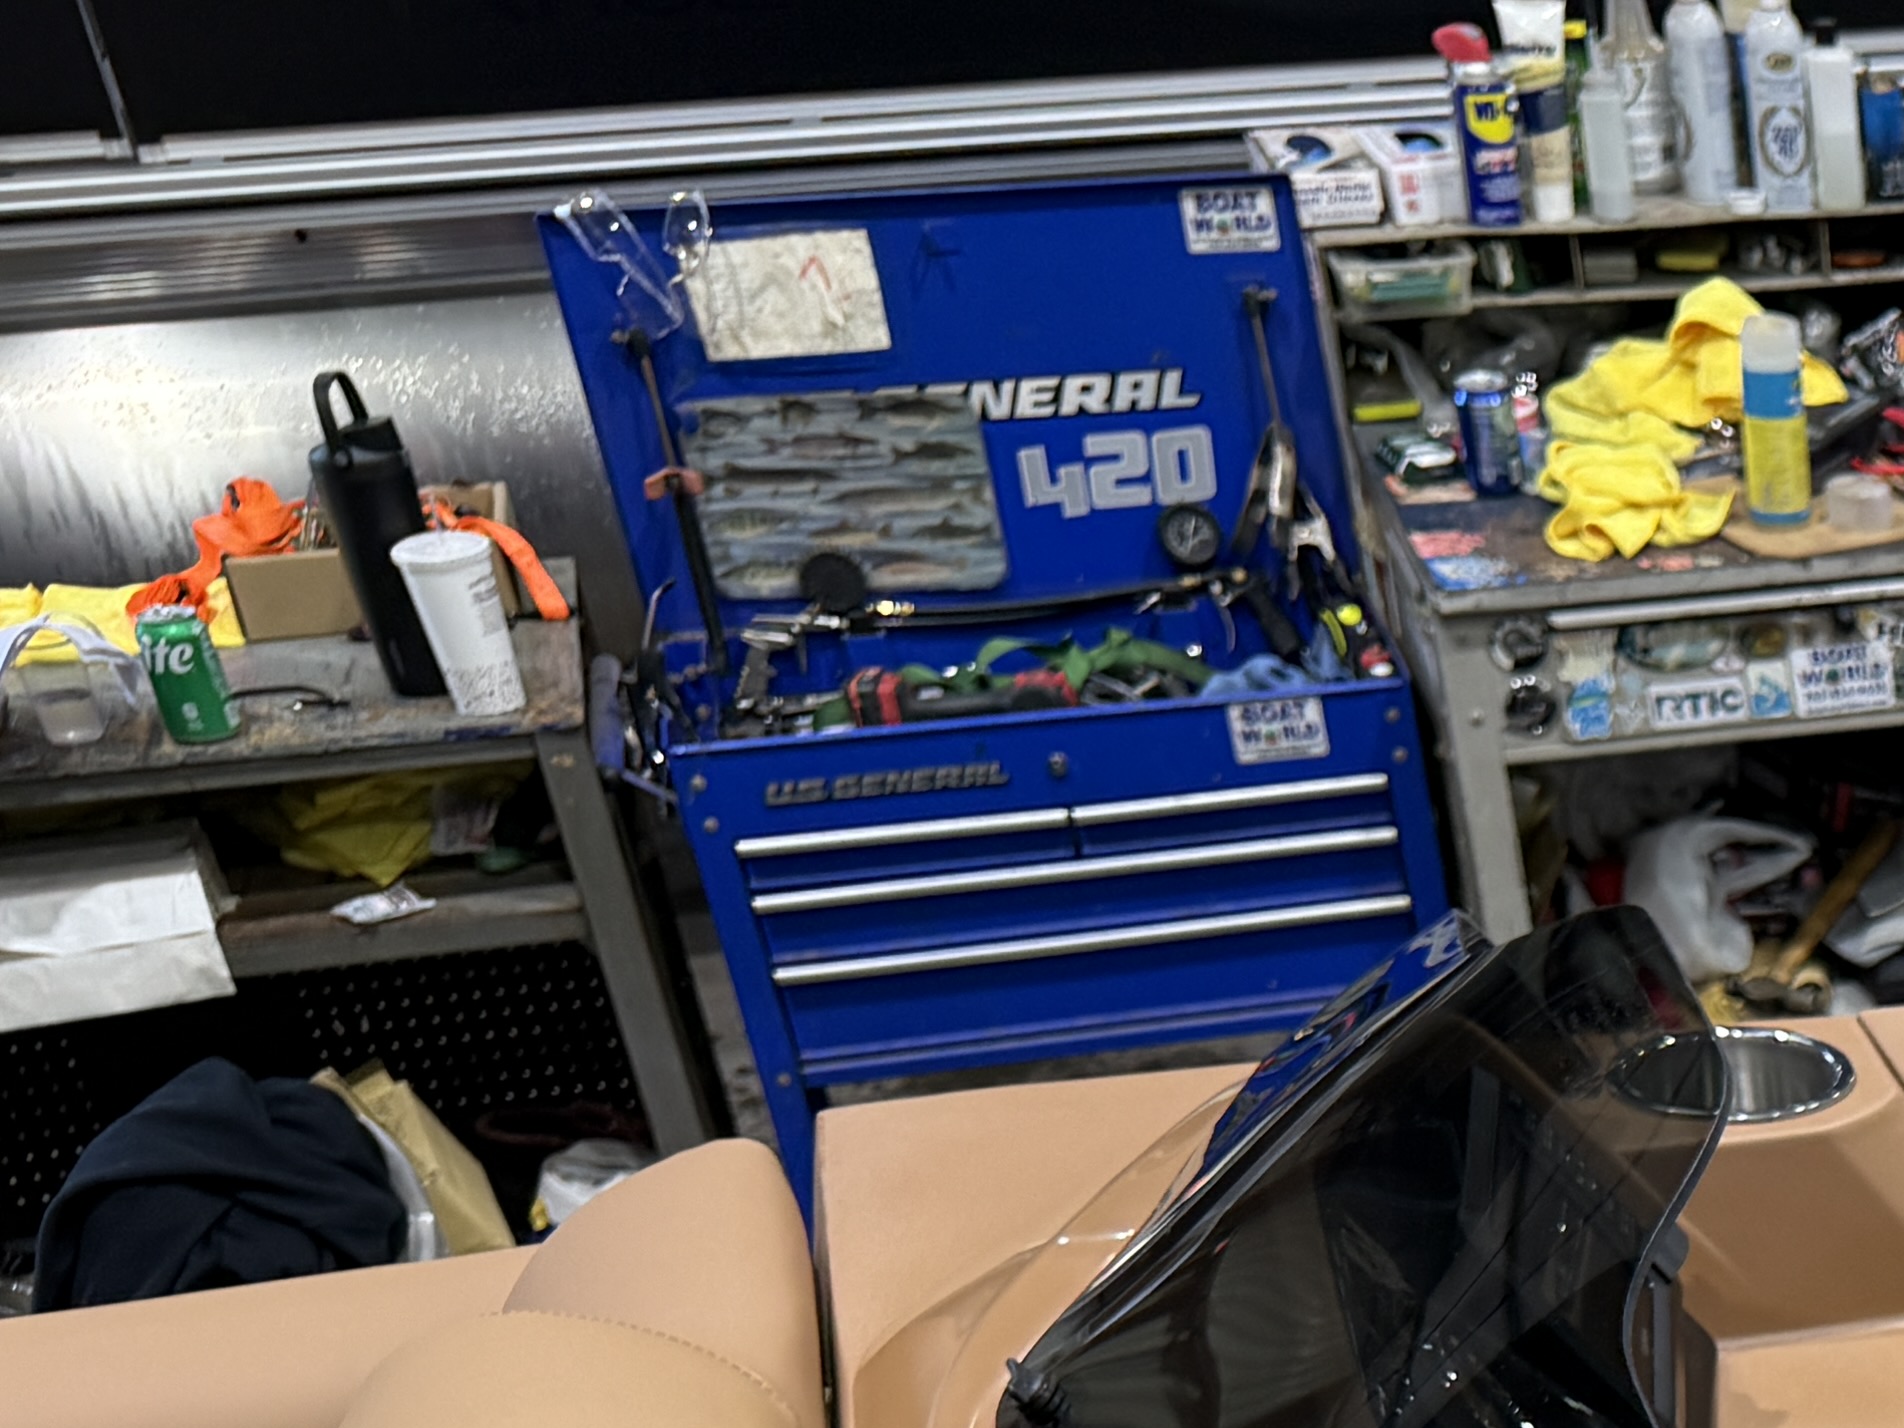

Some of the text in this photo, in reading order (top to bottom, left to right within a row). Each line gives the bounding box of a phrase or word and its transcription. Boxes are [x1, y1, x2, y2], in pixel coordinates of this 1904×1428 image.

[1195, 191, 1257, 214] BOAT
[867, 367, 1201, 421] NERAL
[1016, 424, 1218, 519] 420
[1241, 700, 1304, 726] BOAT
[1655, 688, 1744, 720] RTIC
[832, 760, 1010, 801] GENERAL
